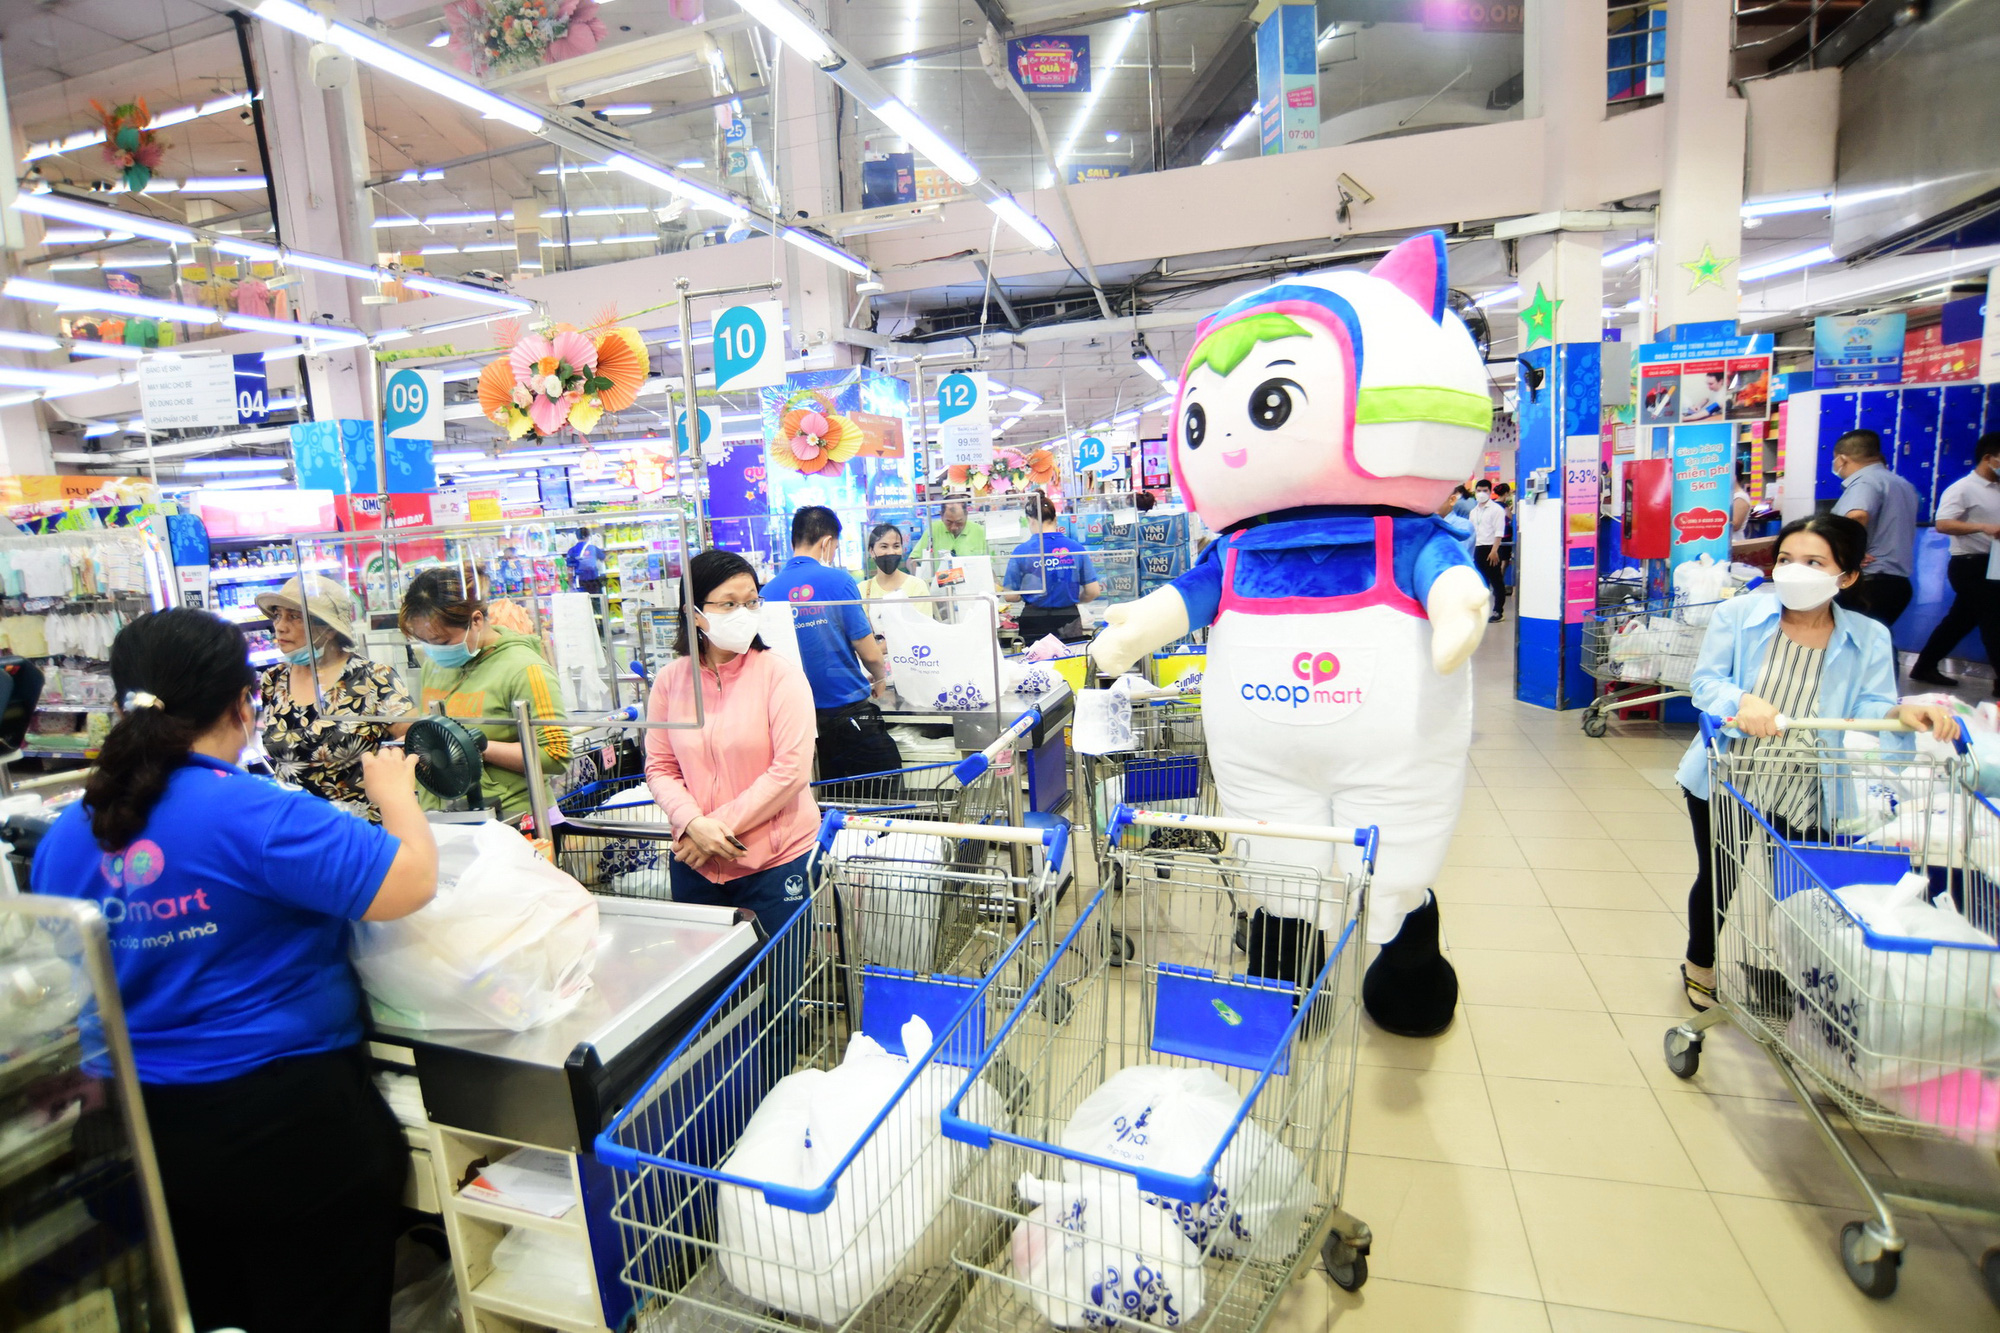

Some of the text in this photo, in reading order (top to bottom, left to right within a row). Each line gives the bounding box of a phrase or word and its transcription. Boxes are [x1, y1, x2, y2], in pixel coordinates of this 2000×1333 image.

[727, 125, 744, 138] 25
[1289, 130, 1315, 139] 07:00
[1087, 168, 1110, 178] SALE
[719, 323, 756, 361] 10
[392, 383, 424, 414] 09
[941, 384, 969, 407] 12
[239, 390, 267, 418] 04
[1082, 444, 1099, 458] 14
[1676, 444, 1723, 456] Giao hàng
[1685, 454, 1719, 466] tận nhà
[744, 467, 767, 482] QU
[1568, 469, 1597, 484] 2-3%
[1677, 463, 1730, 480] miễn phí
[1691, 481, 1717, 491] 5km
[407, 513, 424, 525] BAY
[1144, 525, 1165, 533] VINH
[1147, 557, 1168, 565] VINH
[142, 931, 175, 949] mọi
